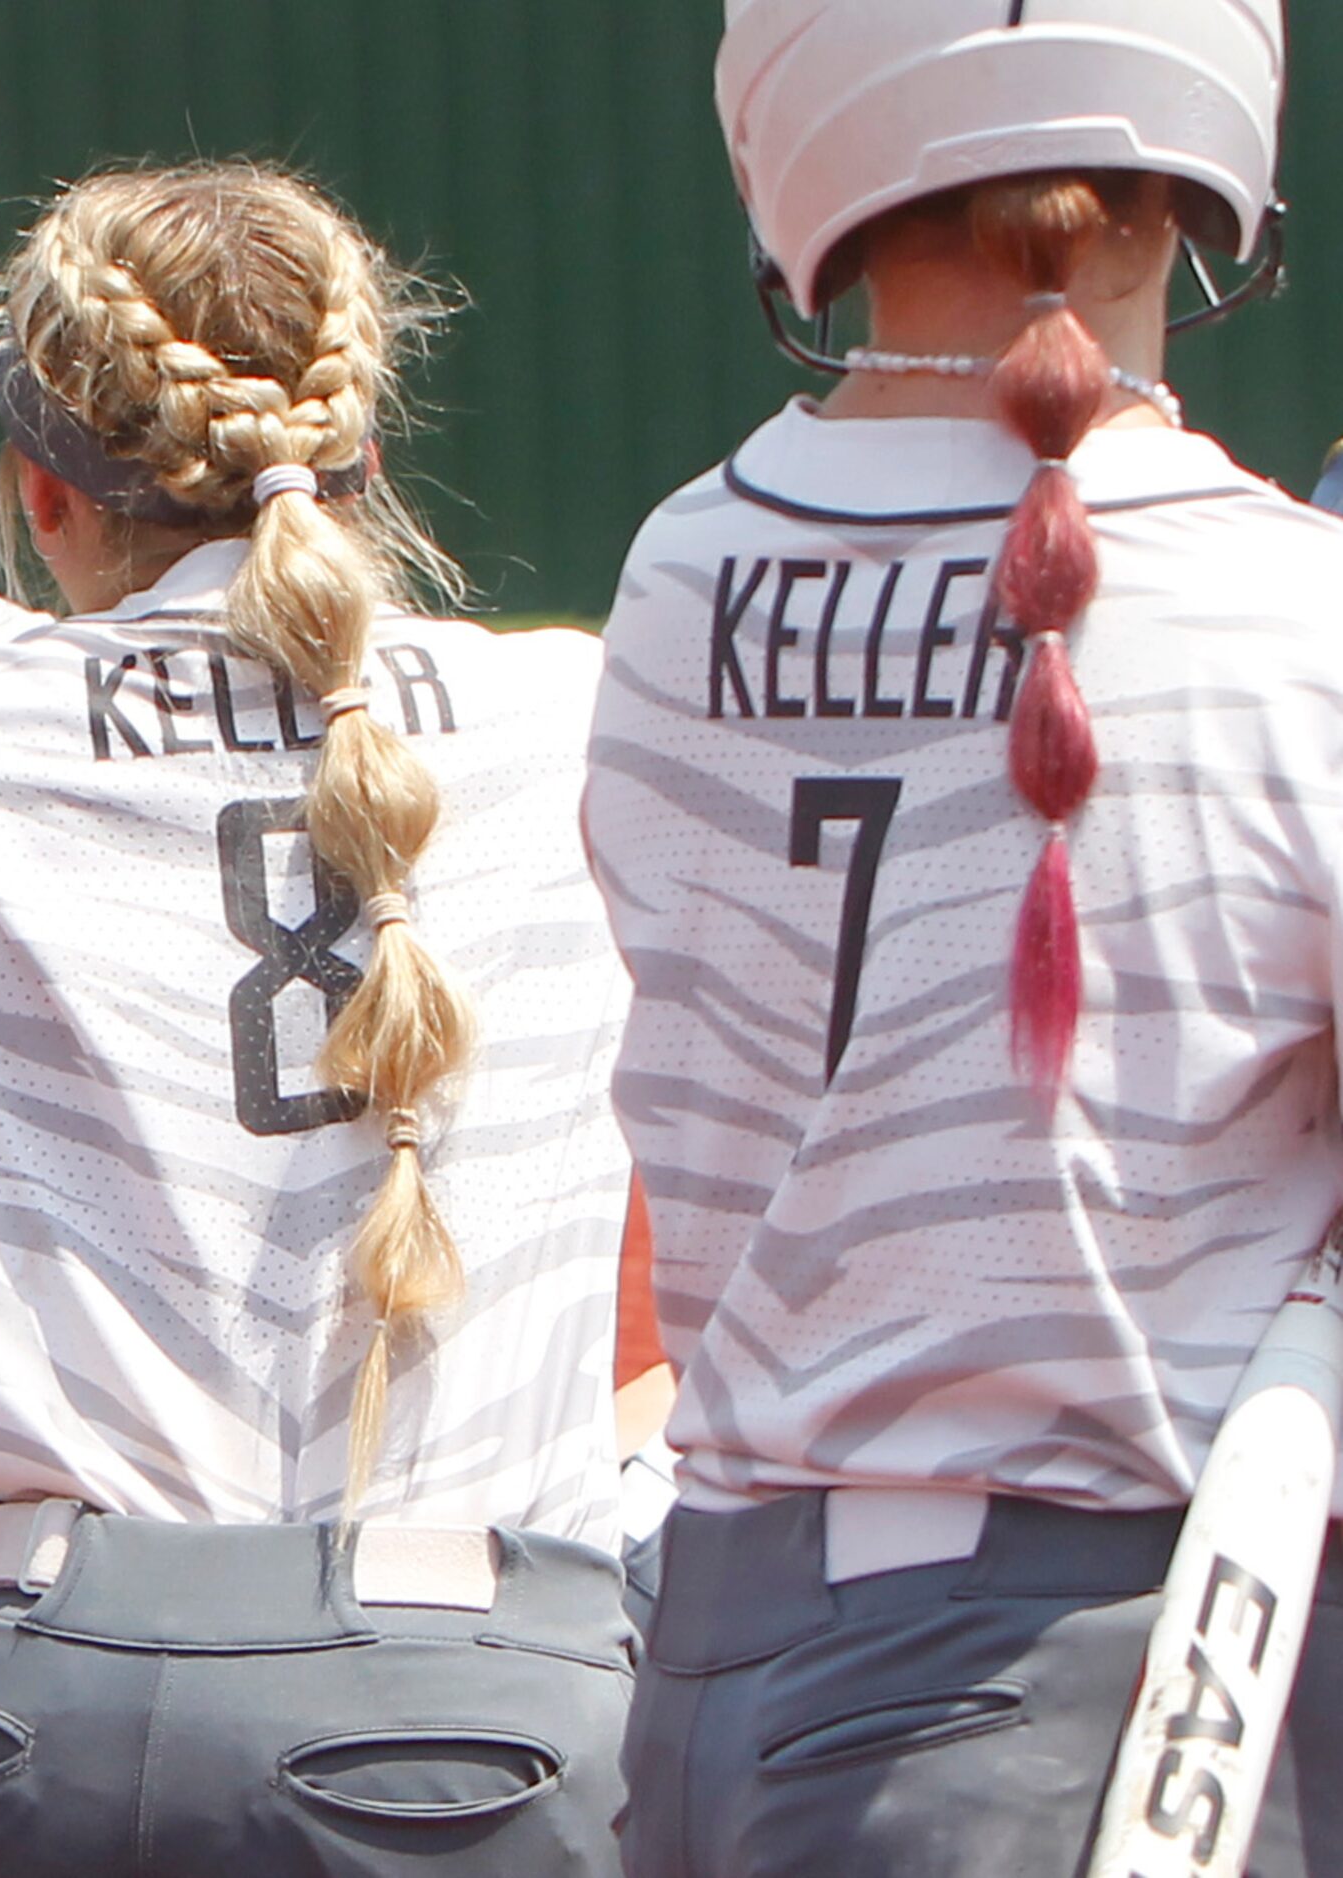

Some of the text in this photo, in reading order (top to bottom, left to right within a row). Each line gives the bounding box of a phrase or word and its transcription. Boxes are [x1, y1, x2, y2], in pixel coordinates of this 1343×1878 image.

[84, 643, 457, 762] KELLR
[216, 797, 371, 1136] 8
[789, 777, 903, 1091] 7
[1127, 1552, 1278, 1878] EAS
